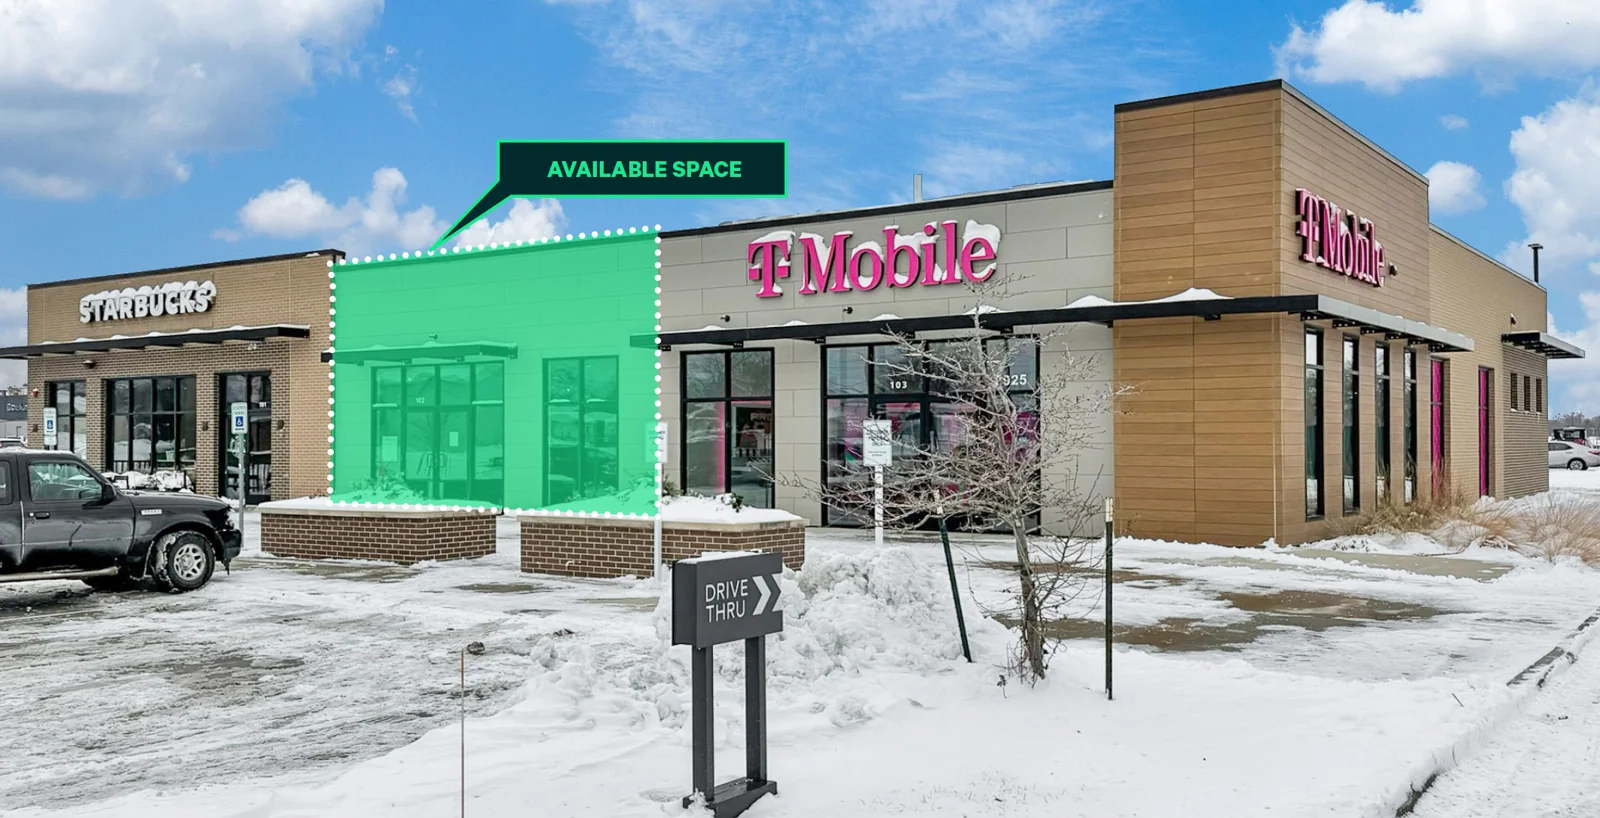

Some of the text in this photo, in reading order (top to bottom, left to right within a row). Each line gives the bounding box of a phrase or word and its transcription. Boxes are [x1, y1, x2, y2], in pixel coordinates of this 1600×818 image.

[1295, 189, 1385, 287] T Mobile
[748, 221, 997, 298] T Mobile
[79, 286, 209, 324] STARBUCKS
[890, 380, 908, 389] 103
[706, 579, 747, 602] DRIVE
[706, 600, 745, 622] THRU
